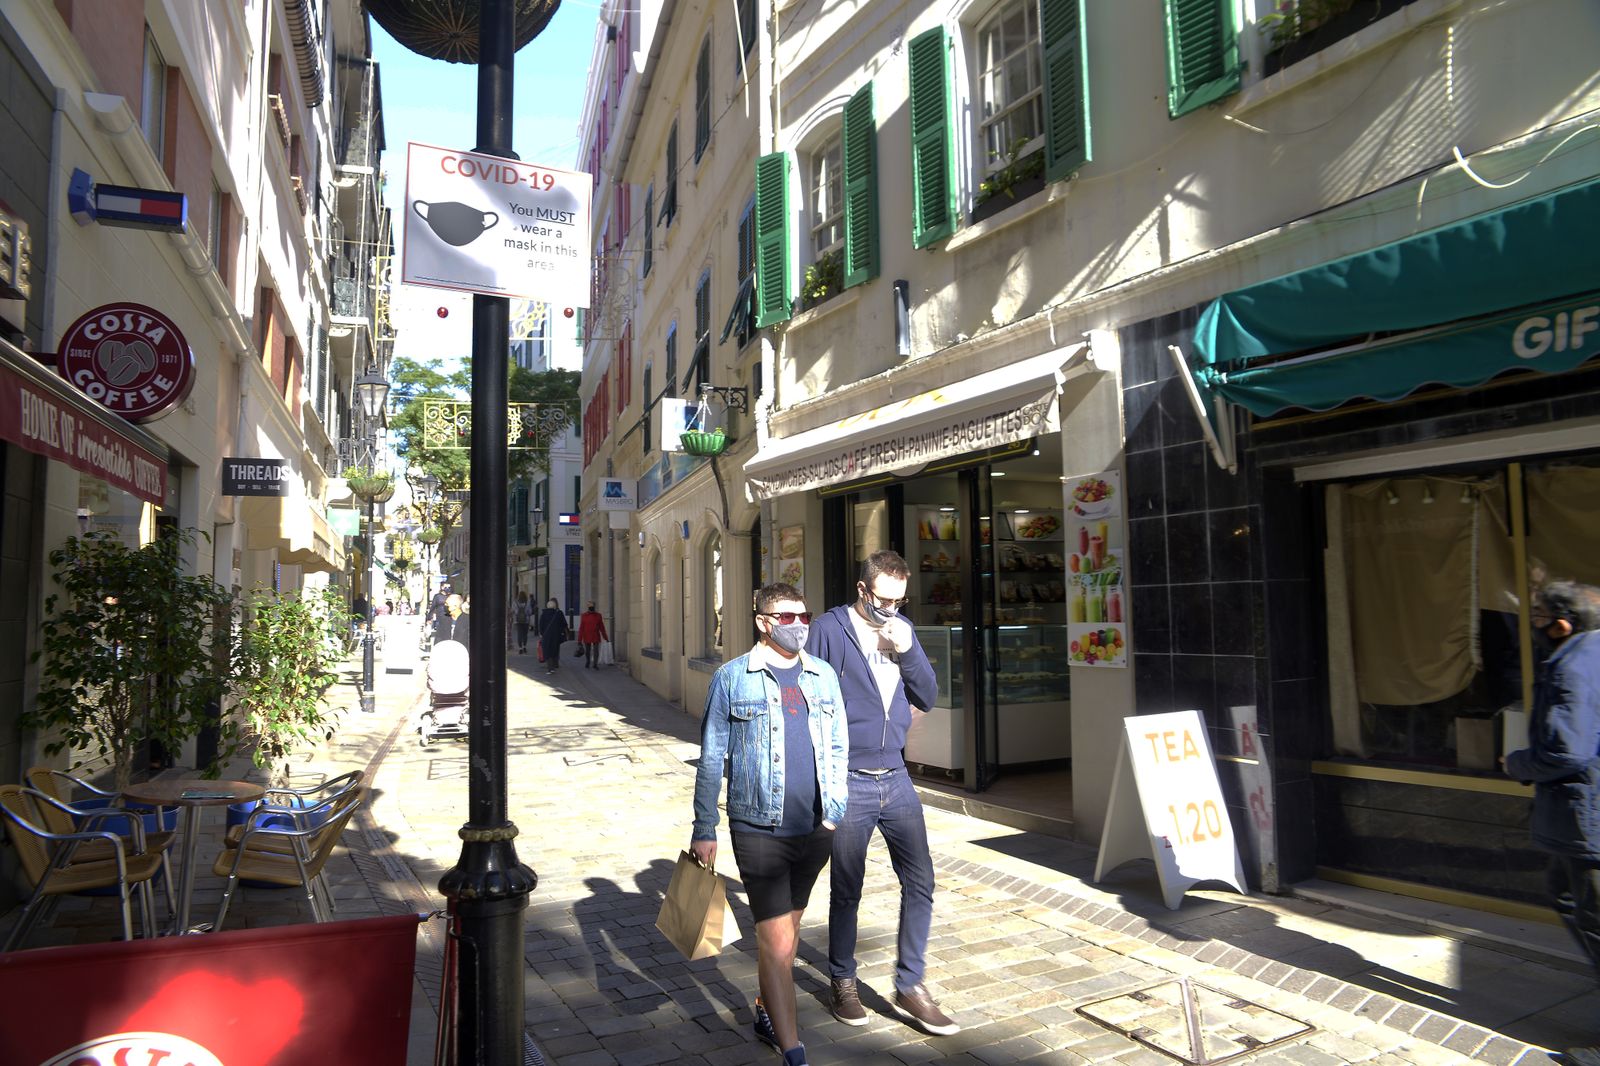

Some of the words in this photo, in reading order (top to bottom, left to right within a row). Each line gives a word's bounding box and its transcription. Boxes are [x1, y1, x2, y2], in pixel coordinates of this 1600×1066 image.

[441, 155, 556, 192] COVID-19
[508, 201, 533, 217] You
[536, 206, 575, 224] MUST
[521, 223, 553, 237] wear
[556, 229, 562, 239] a
[503, 238, 537, 253] mask
[540, 240, 552, 255] in
[555, 244, 578, 258] this
[83, 313, 166, 346] COSTA
[1512, 305, 1600, 360] GIF
[69, 347, 92, 358] SINCE
[161, 353, 178, 364] 1971
[74, 369, 174, 409] COFFEE
[20, 387, 60, 449] HOME
[60, 410, 75, 456] OF
[78, 420, 133, 482] irresistible
[134, 454, 162, 497] COFFEE
[229, 464, 289, 482] THREADS
[1144, 729, 1200, 765] TEA
